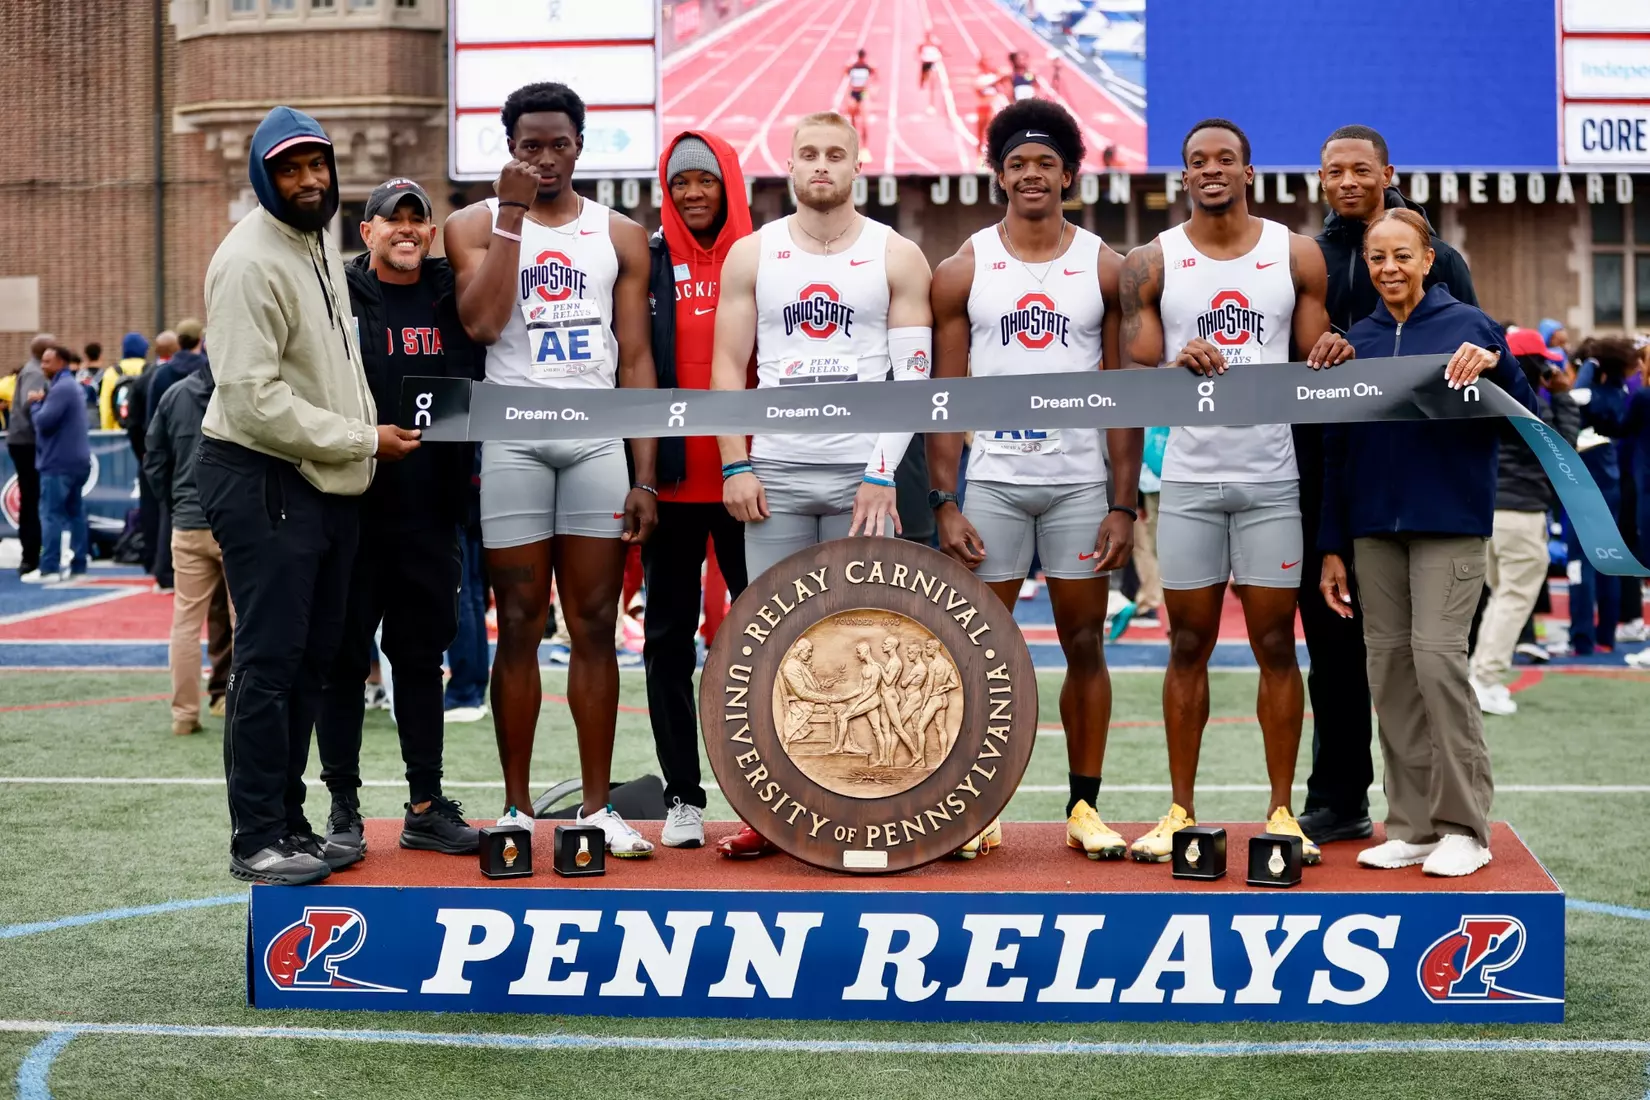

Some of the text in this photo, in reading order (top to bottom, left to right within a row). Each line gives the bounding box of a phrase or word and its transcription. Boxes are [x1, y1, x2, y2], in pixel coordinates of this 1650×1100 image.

[1582, 118, 1648, 152] CORE
[931, 175, 1132, 206] JOON
[1393, 171, 1634, 204] OREBOARD
[552, 309, 592, 320] RELAYS
[553, 303, 581, 311] PENN
[401, 327, 444, 355] STA
[536, 329, 592, 362] AE
[1219, 348, 1242, 356] ENN
[808, 366, 850, 374] RELAYS
[1296, 383, 1383, 400] Dream On.
[1030, 394, 1116, 409] Dream On.
[505, 407, 590, 421] Dream On.
[766, 403, 852, 419] Dream On.
[744, 561, 991, 647] RELAY CARNIVAL
[725, 662, 1012, 848] UNIVERSITY OF PENNSYLVANIA
[420, 908, 1402, 1005] PENN RELAYS
